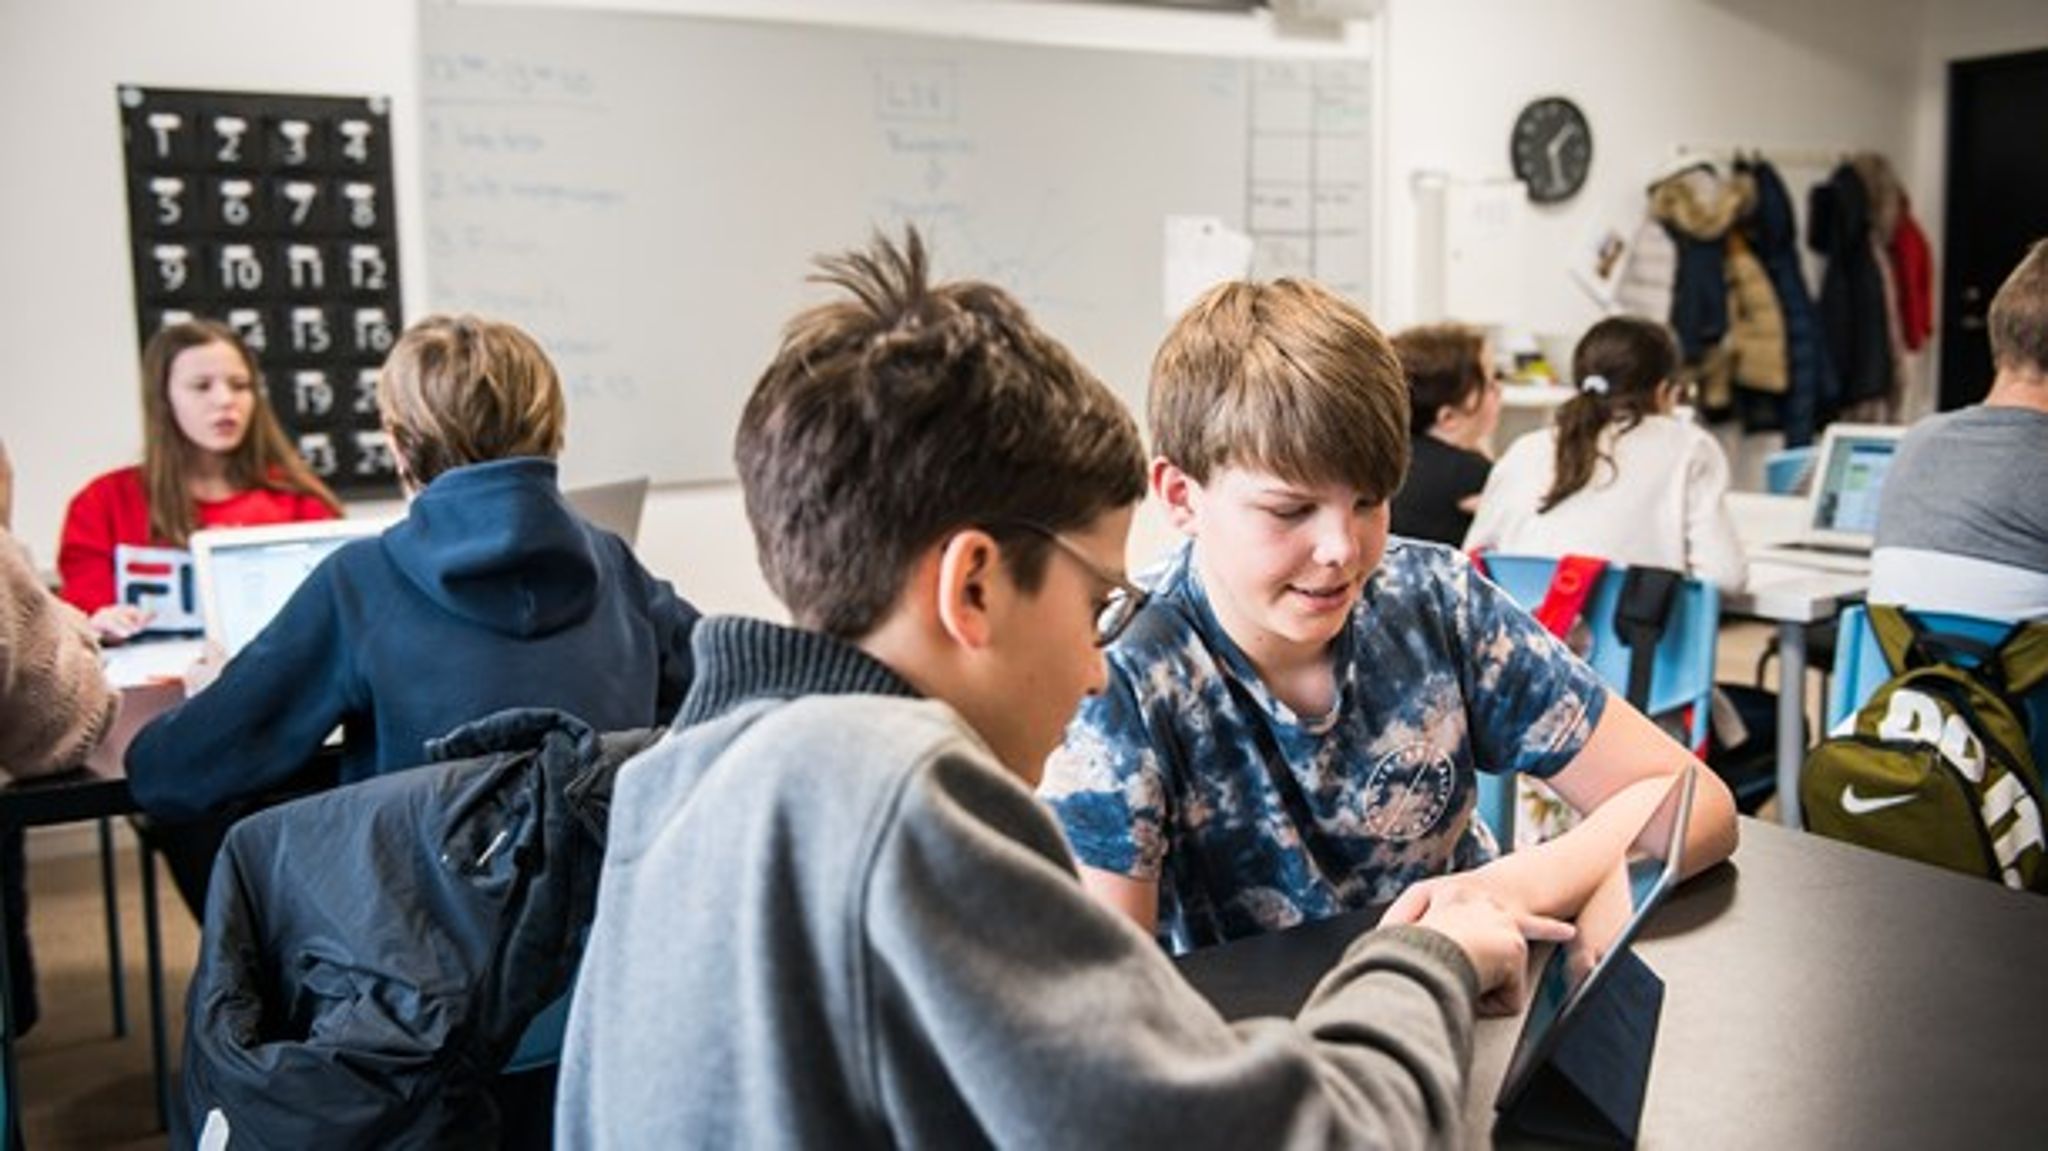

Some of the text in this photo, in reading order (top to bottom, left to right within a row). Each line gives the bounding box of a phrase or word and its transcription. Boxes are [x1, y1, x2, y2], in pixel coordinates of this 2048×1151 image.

[151, 114, 370, 164] 1 2 3 4
[153, 178, 182, 225] 5
[221, 181, 251, 225] 6
[286, 183, 315, 226] 7
[156, 245, 386, 290] 9 10 11 12
[292, 307, 330, 351] 15
[355, 307, 392, 350] 16
[296, 371, 333, 414] 19
[126, 562, 194, 614] FI
